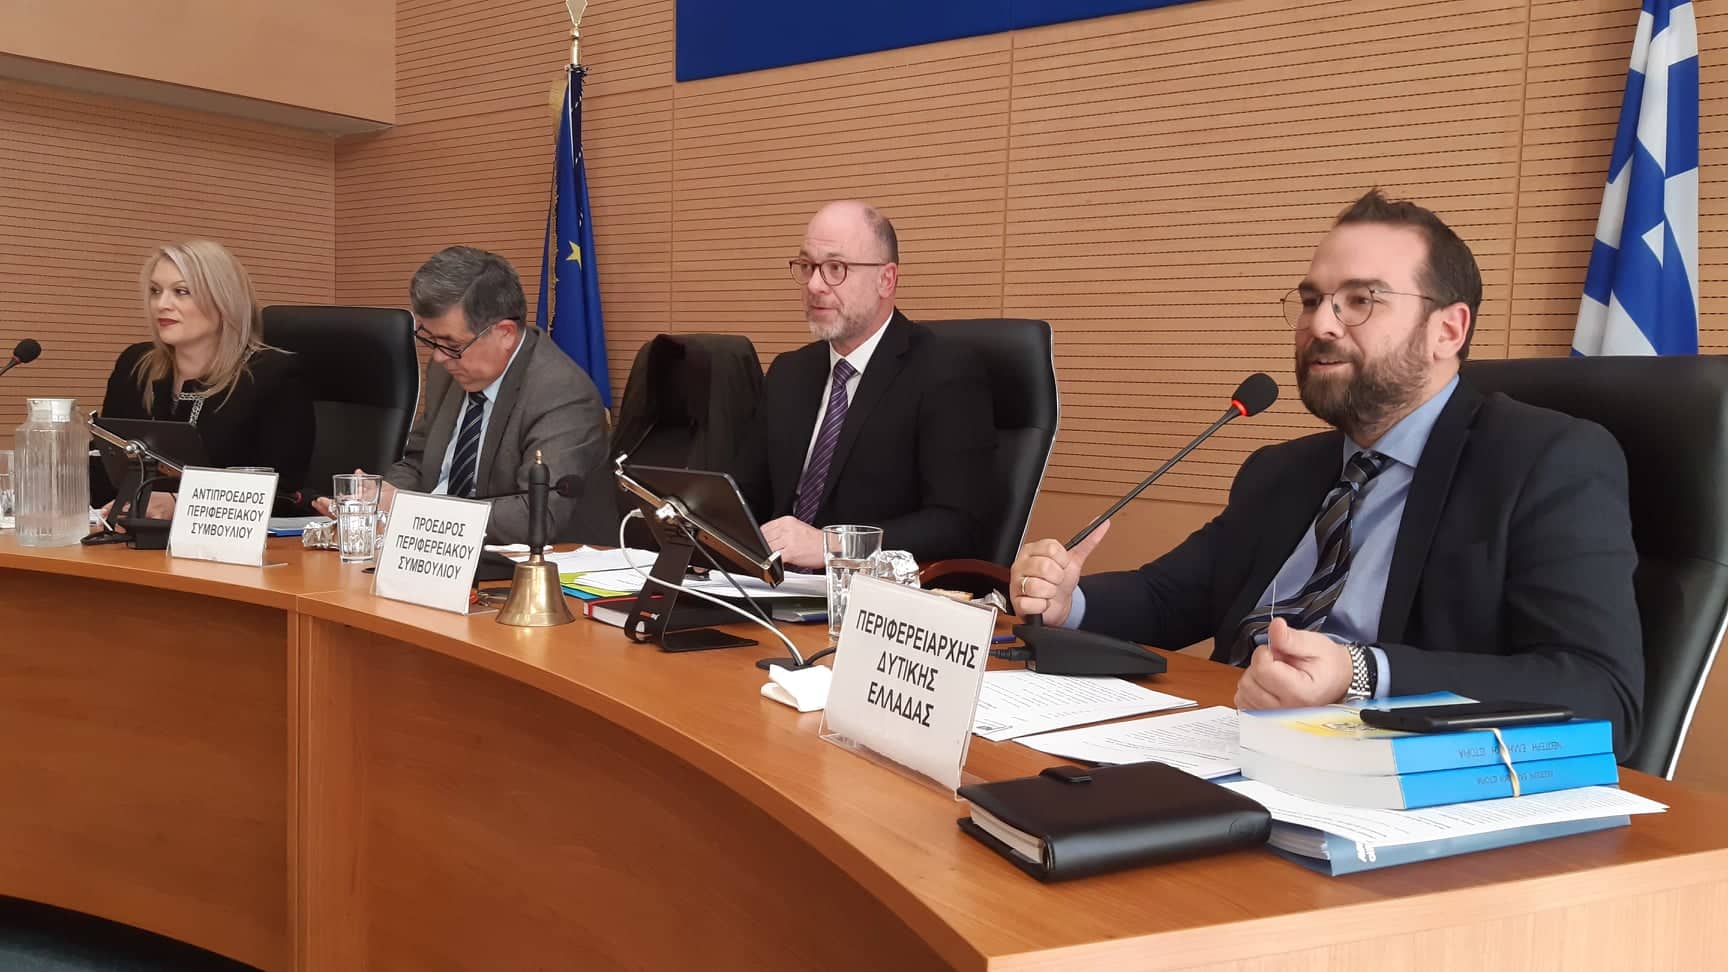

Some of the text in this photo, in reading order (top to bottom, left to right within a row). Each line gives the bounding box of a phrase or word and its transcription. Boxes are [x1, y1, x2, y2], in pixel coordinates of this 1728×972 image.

[192, 488, 265, 504] ΑΝΤΙΠΡΟΕΔΡΟΣ
[187, 504, 264, 522] ΠΕΡΙΦΕΡΕΙΑΚΟΥ
[191, 522, 253, 539] ΣΥΜΒΟΥΛΙΟΥ
[413, 516, 466, 537] ΠΡΟΕΔΡΟΣ
[395, 534, 474, 560] ΠΕΡΙΦΕΡΕΙΑΚΟΥ
[398, 556, 462, 579] ΣΥΜΒΟΥΛΙΟΥ
[856, 609, 979, 669] ΠΕΡΙΦΕΡΕΙΑΡΧΗΣ
[877, 651, 938, 691] ΔΥΤΙΚΗΣ
[867, 681, 934, 727] ΕΛΛΑΔΑΣ
